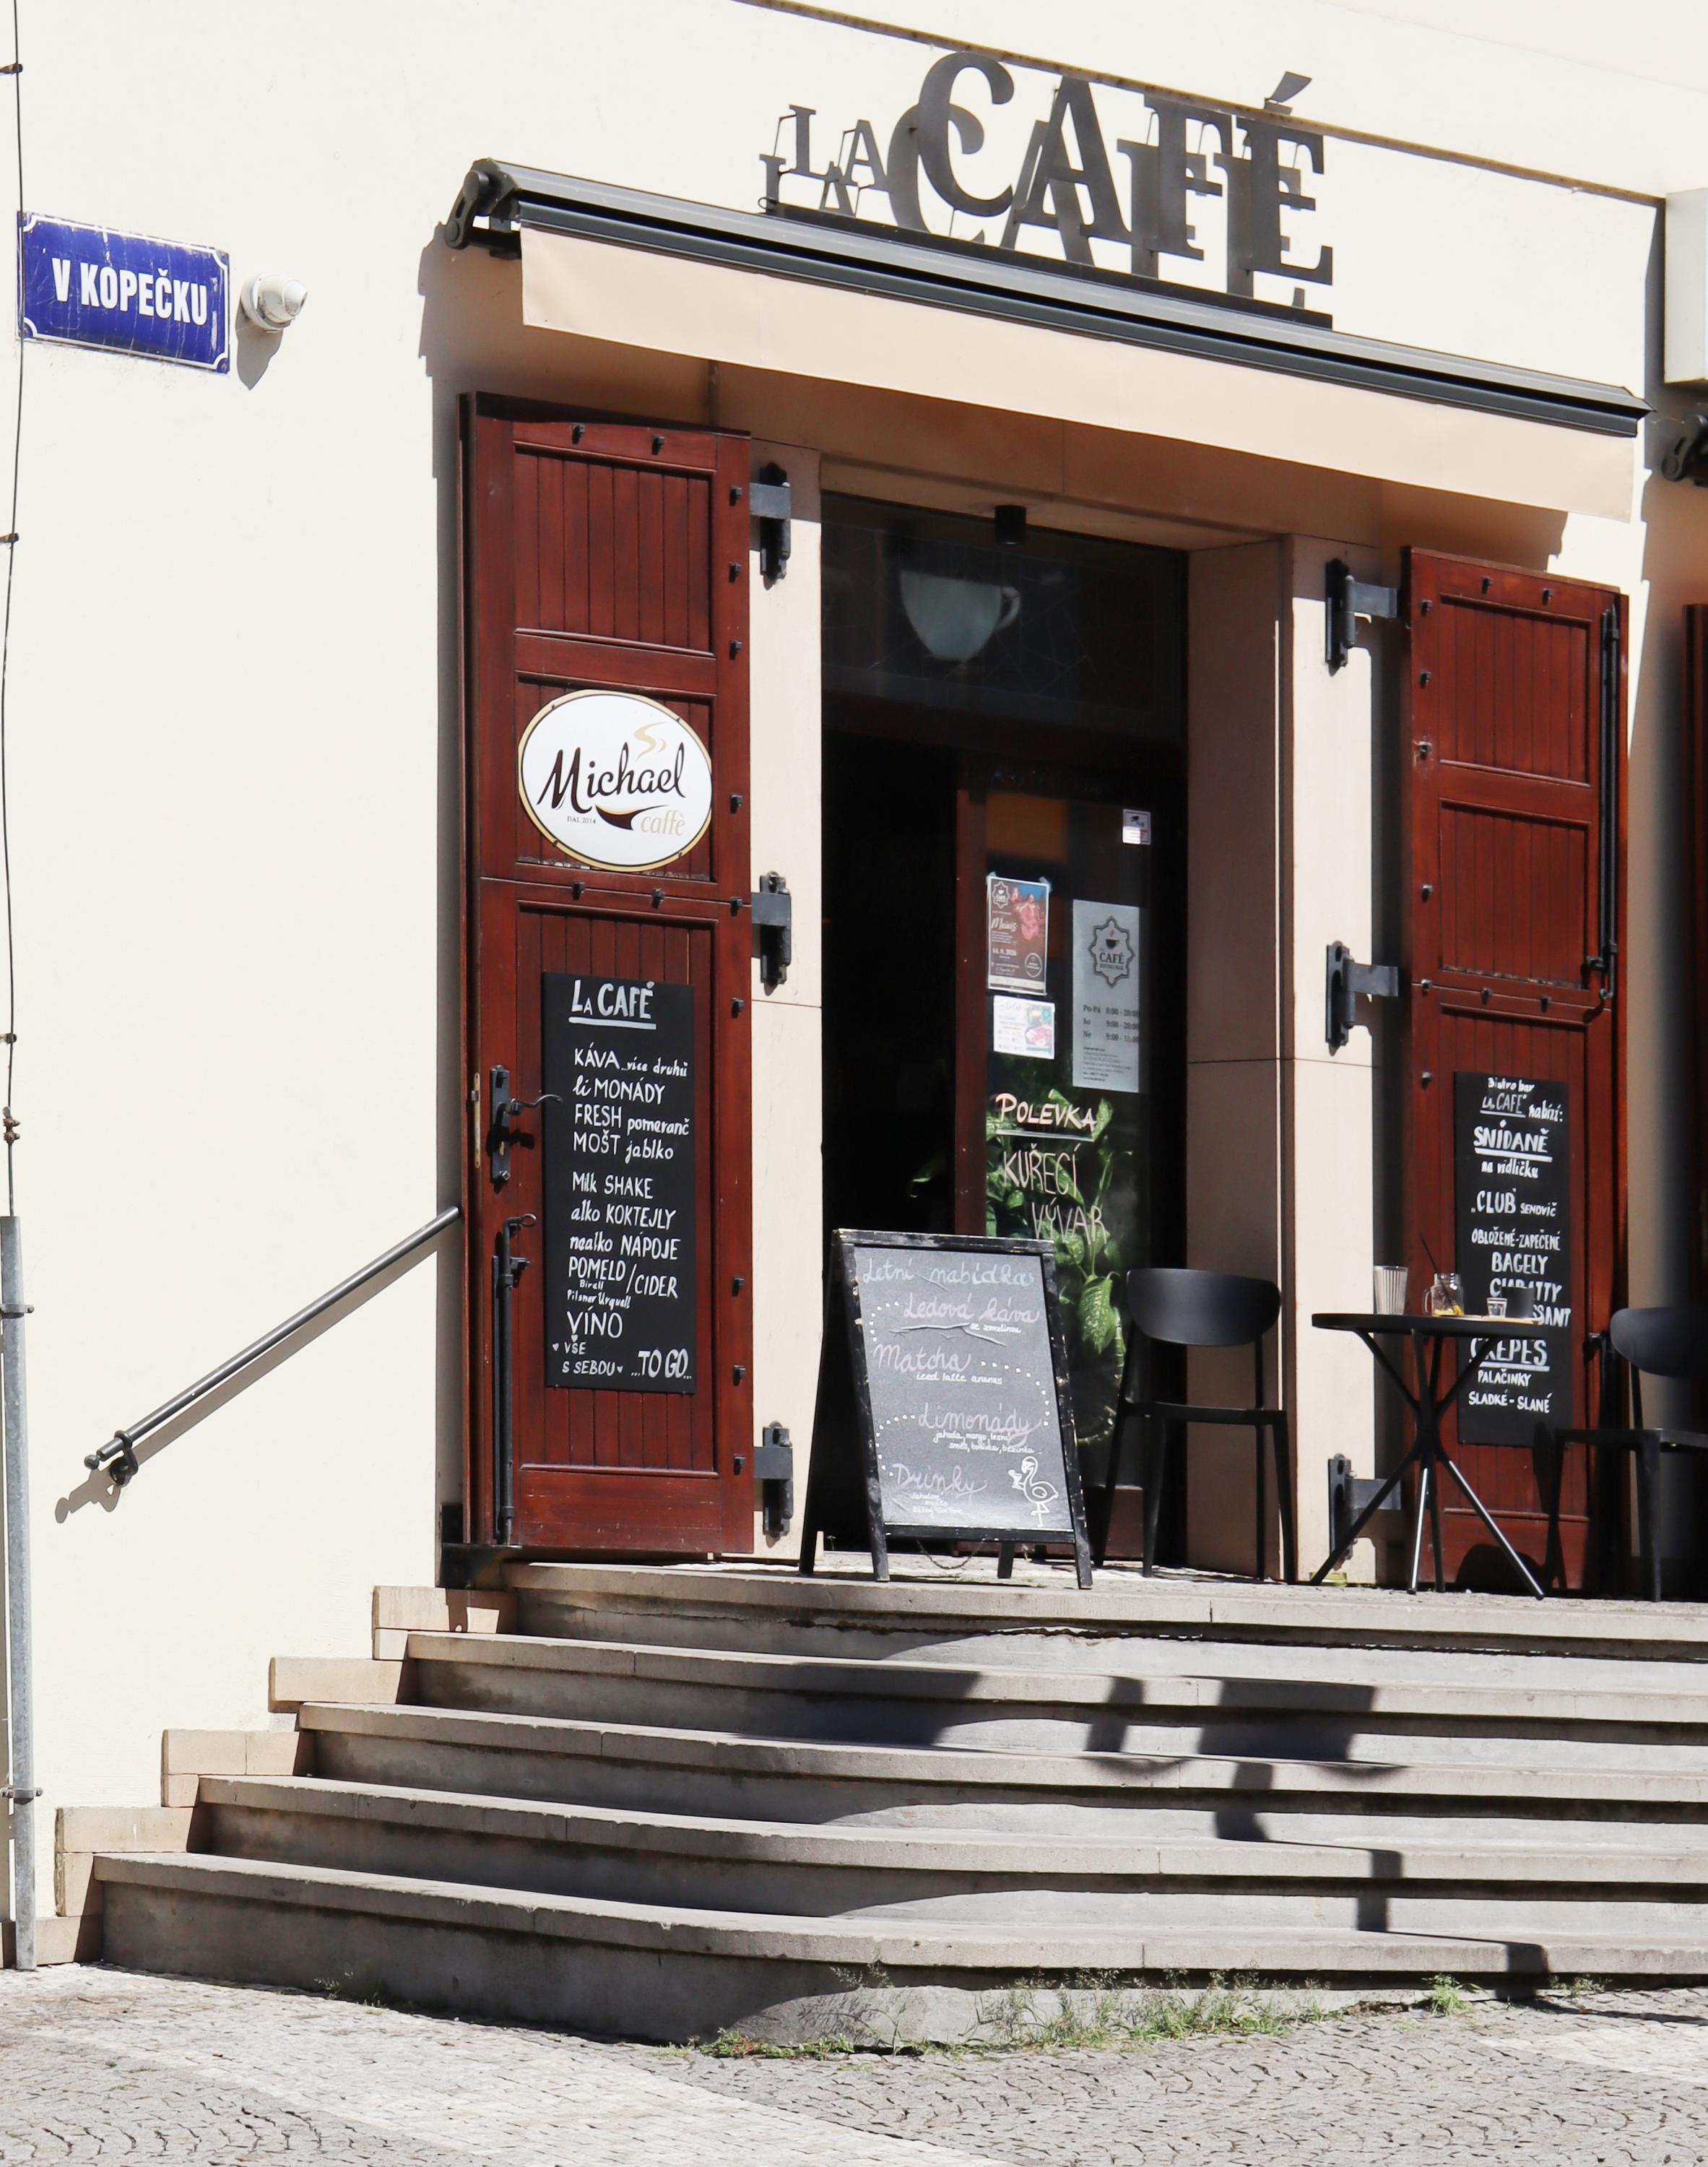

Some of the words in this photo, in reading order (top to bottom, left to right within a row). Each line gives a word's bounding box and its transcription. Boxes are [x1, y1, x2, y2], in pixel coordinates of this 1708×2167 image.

[789, 104, 891, 193] LA
[918, 52, 1332, 286] CAFÉ
[51, 258, 71, 302] V
[80, 268, 208, 326] KOPEČKU
[537, 741, 686, 814] Michael
[641, 810, 685, 836] caffè
[597, 981, 655, 1019] CAFÉ
[1518, 1079, 1535, 1092] bar
[575, 1104, 622, 1128] FRESH
[627, 1118, 690, 1136] pomeranč
[573, 1129, 621, 1155] MOŠT
[625, 1138, 674, 1164] jablko
[1473, 1119, 1550, 1153] SNÍDANĚ
[1004, 1143, 1080, 1198] KUŘECÍ
[1481, 1161, 1493, 1173] na
[1497, 1159, 1538, 1178] vidličku
[604, 1175, 654, 1199] SHAKE
[571, 1199, 600, 1222] alko
[606, 1203, 677, 1230] KOKTEJLY
[1032, 1197, 1107, 1245] VÝVAR
[570, 1231, 613, 1252] nealko
[620, 1231, 681, 1260] NÁPOJE
[862, 1258, 915, 1283] Letní
[928, 1262, 1034, 1286] nabídka
[1491, 1251, 1548, 1275] BAGELY
[598, 1292, 631, 1311] Urquell
[903, 1292, 974, 1320] Ledová
[979, 1297, 1040, 1323] káva
[567, 1306, 623, 1338] VÍNO
[562, 1361, 570, 1373] S
[573, 1360, 615, 1376] SEBOU
[873, 1344, 971, 1372] Matcha
[916, 1372, 939, 1381] iced
[942, 1373, 967, 1382] latte
[971, 1375, 1002, 1385] ananas
[1478, 1368, 1531, 1387] PALAČINKY
[1468, 1390, 1508, 1406] SLADKÉ
[1517, 1393, 1553, 1414] SLANÉ
[919, 1403, 1042, 1446] Limonády
[892, 1463, 987, 1502] Drinky
